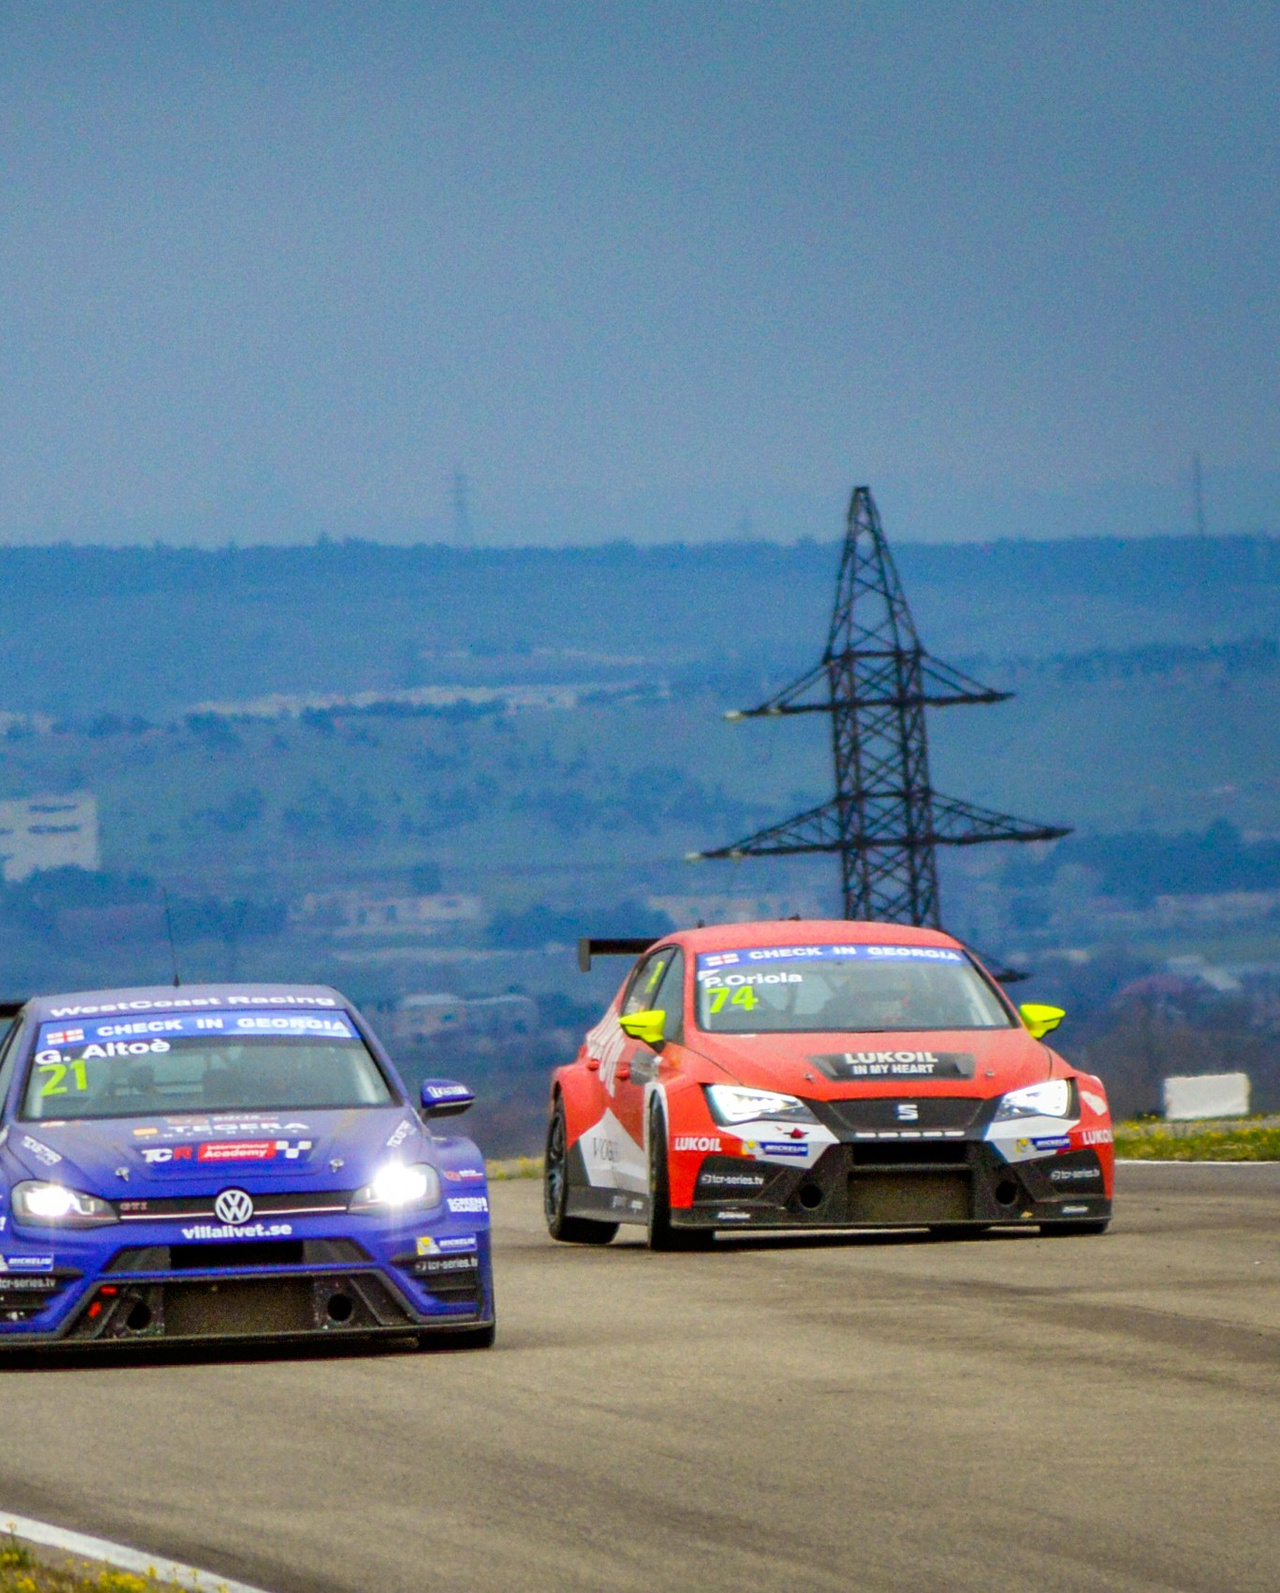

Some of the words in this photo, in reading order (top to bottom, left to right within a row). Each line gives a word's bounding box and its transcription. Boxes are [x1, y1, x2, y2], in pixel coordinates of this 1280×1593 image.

[749, 947, 823, 960] CHECK
[833, 946, 856, 955] IN
[867, 947, 961, 961] GEORGIA
[50, 998, 221, 1017] WestCoast
[228, 996, 335, 1006] Racing
[706, 986, 758, 1014] 74
[97, 1020, 183, 1036] CHECK
[197, 1018, 224, 1029] IN
[237, 1018, 348, 1031] GEORGIA
[35, 1050, 70, 1065] G.
[81, 1038, 170, 1060] Altoè
[844, 1052, 938, 1064] LUKOIL
[852, 1065, 867, 1075] IN
[870, 1064, 889, 1074] MY
[892, 1064, 934, 1074] HEART
[38, 1060, 88, 1097] 21
[675, 1137, 722, 1152] LUKOIL
[141, 1146, 192, 1162] TCR
[203, 1148, 268, 1159] Academy
[182, 1224, 292, 1239] villalivet.se
